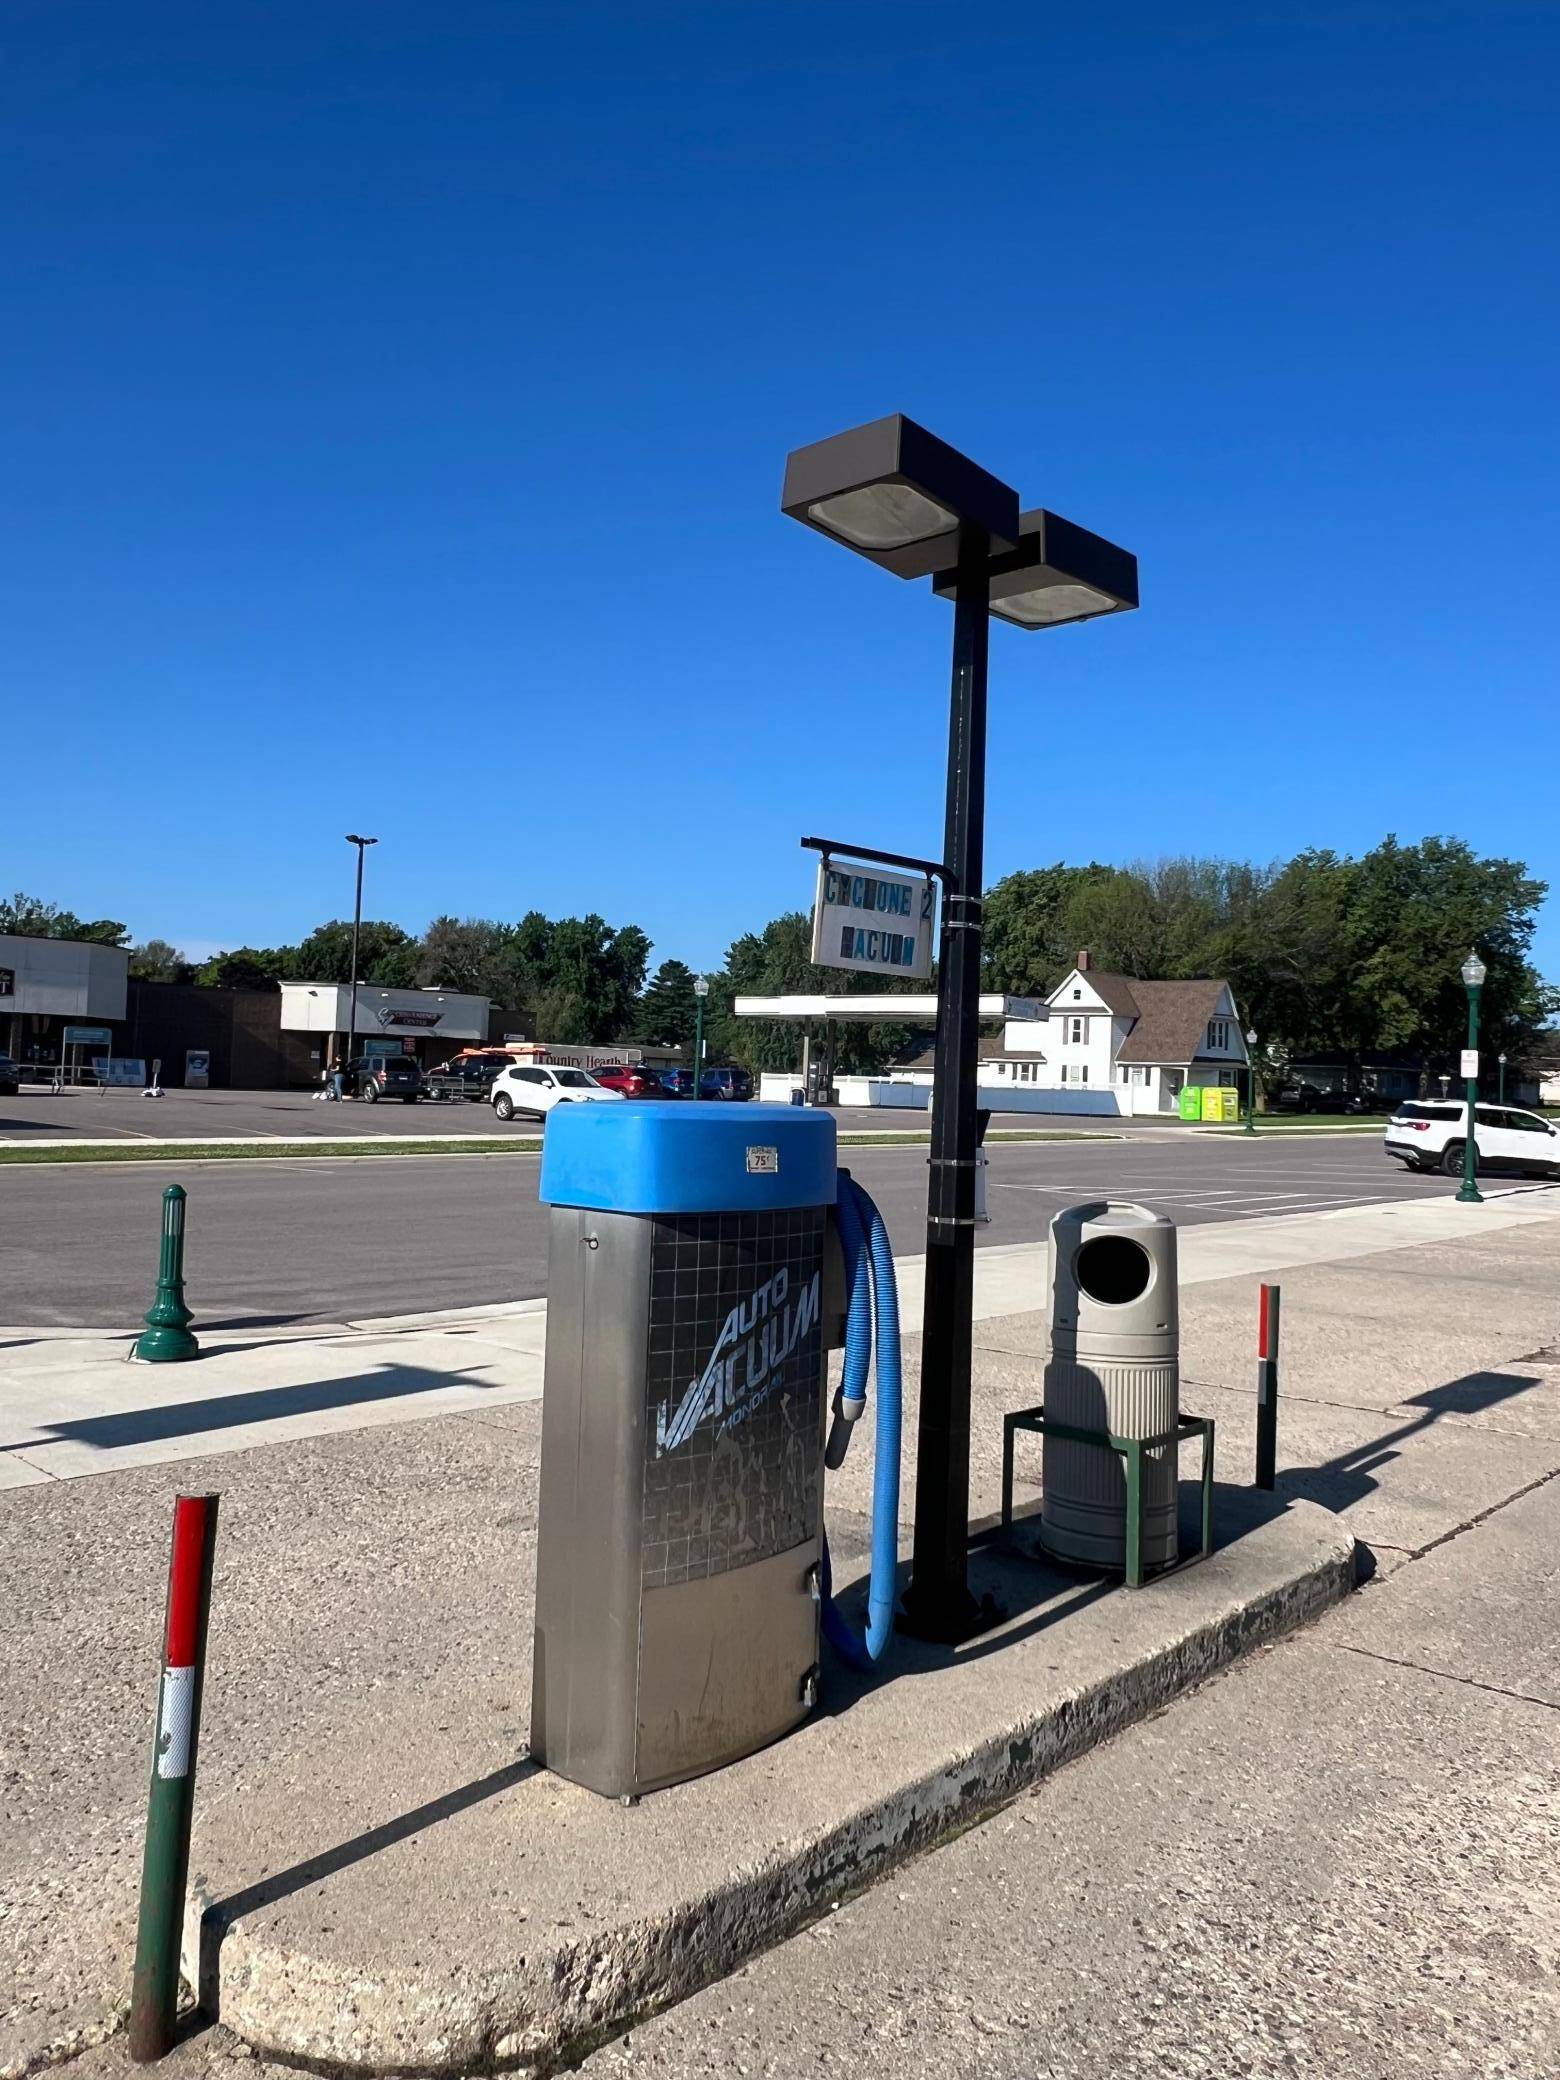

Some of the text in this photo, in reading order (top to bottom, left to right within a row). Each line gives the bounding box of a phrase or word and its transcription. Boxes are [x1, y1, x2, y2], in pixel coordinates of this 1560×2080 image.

[921, 890, 933, 920] 2
[719, 1266, 789, 1346] AUTO
[656, 1270, 820, 1459] VACUUM
